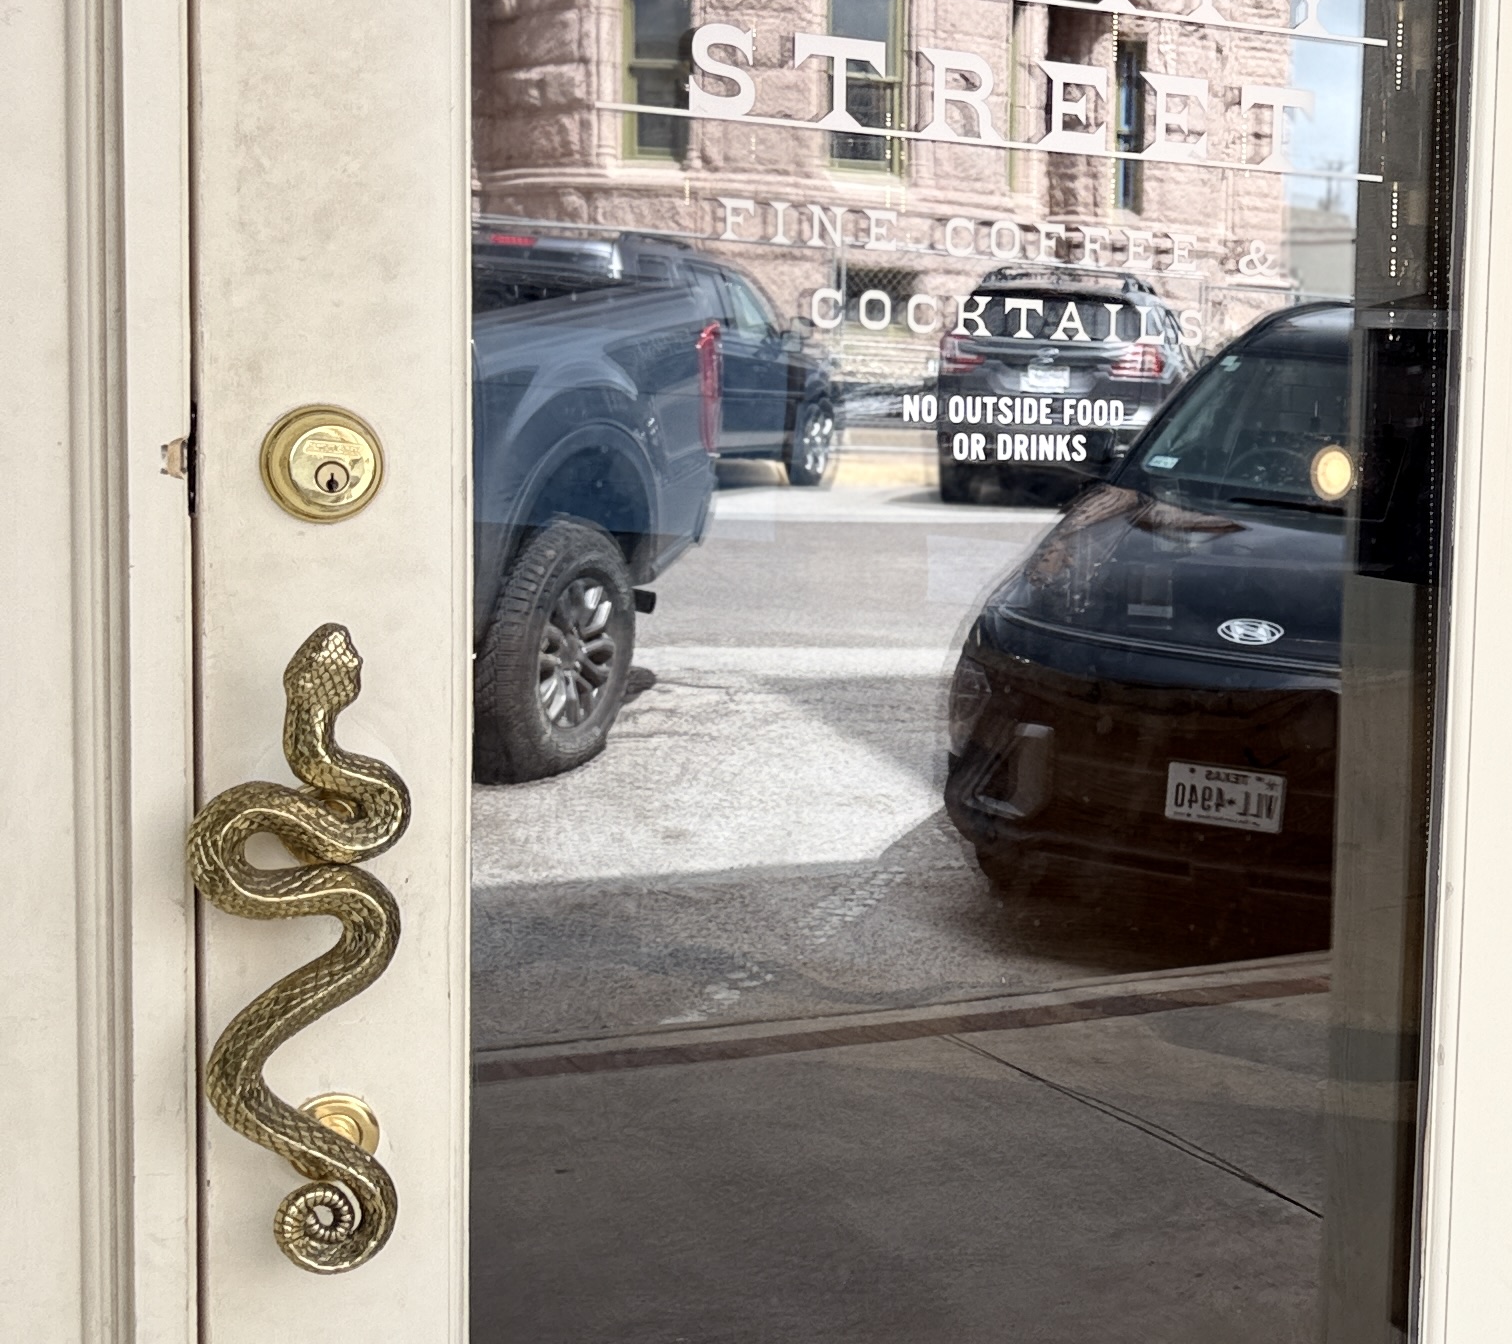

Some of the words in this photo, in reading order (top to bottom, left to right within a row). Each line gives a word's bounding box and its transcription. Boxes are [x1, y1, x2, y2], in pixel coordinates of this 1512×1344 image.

[688, 22, 1315, 172] STREET
[717, 197, 897, 251] FINE
[945, 217, 1198, 272] COFFEE
[1238, 239, 1280, 277] &
[811, 287, 1203, 346] COCKTAILS
[902, 394, 938, 423] NO
[948, 395, 1053, 425] OUTSIDE
[1063, 398, 1125, 427] FOOD
[952, 433, 987, 461] OR
[997, 434, 1087, 462] DRINKS
